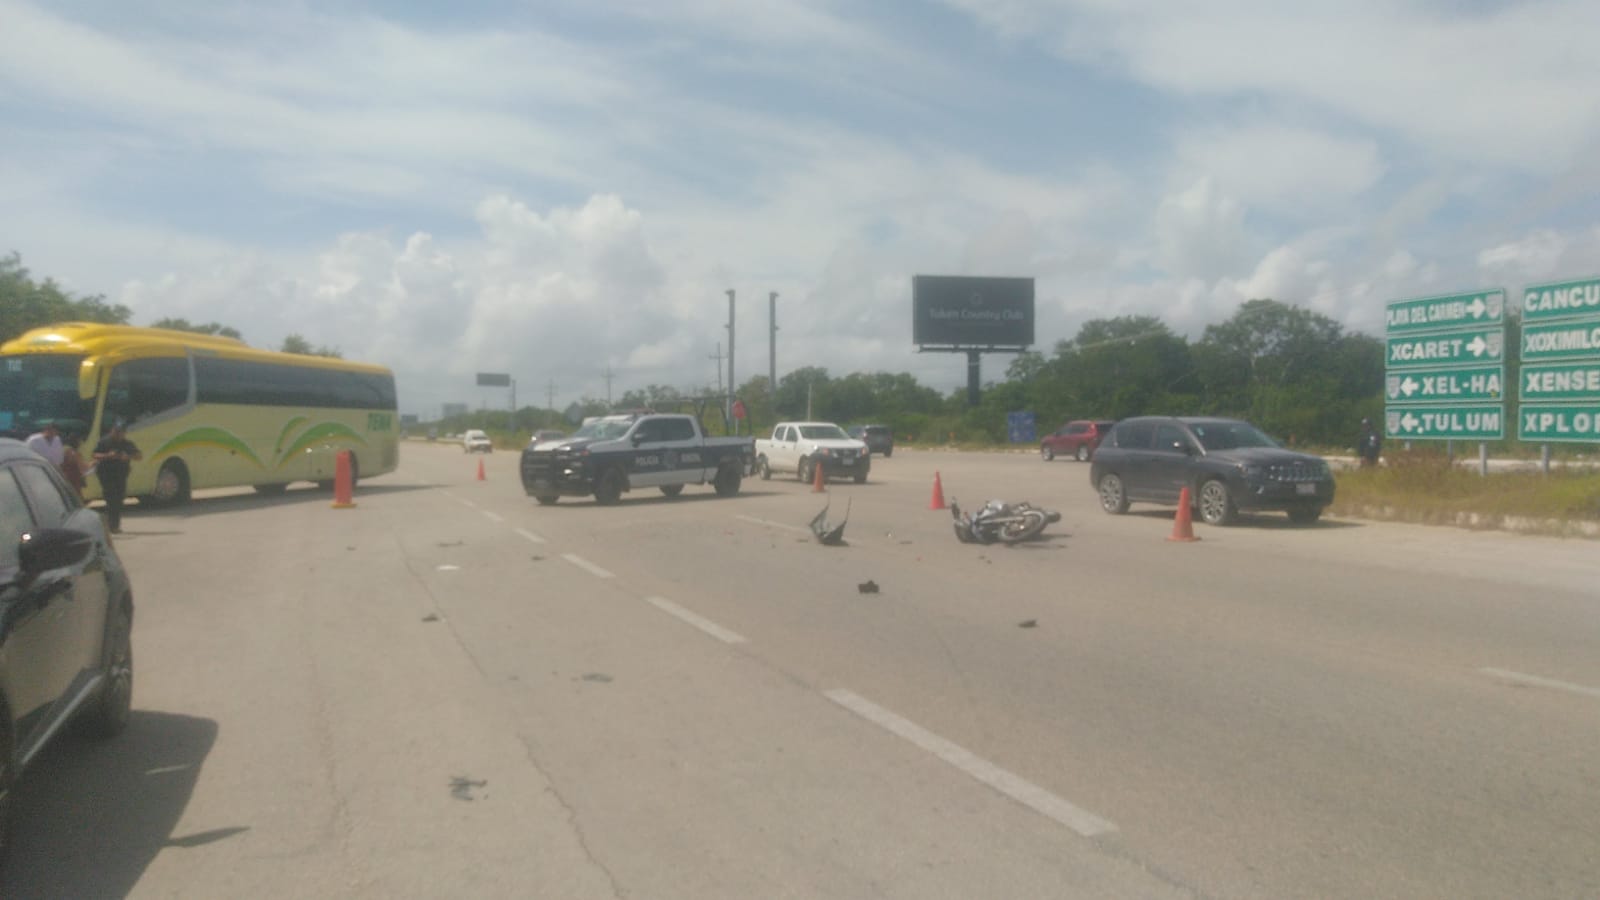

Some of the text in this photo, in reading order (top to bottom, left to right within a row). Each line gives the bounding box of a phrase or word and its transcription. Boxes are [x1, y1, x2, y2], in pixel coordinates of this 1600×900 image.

[1525, 285, 1600, 312] CANCU
[1386, 301, 1466, 327] PLAYA DEL CARMEN
[1391, 339, 1464, 361] XCARET
[1421, 374, 1500, 395] XEL-HA
[1526, 370, 1600, 392] XENSE
